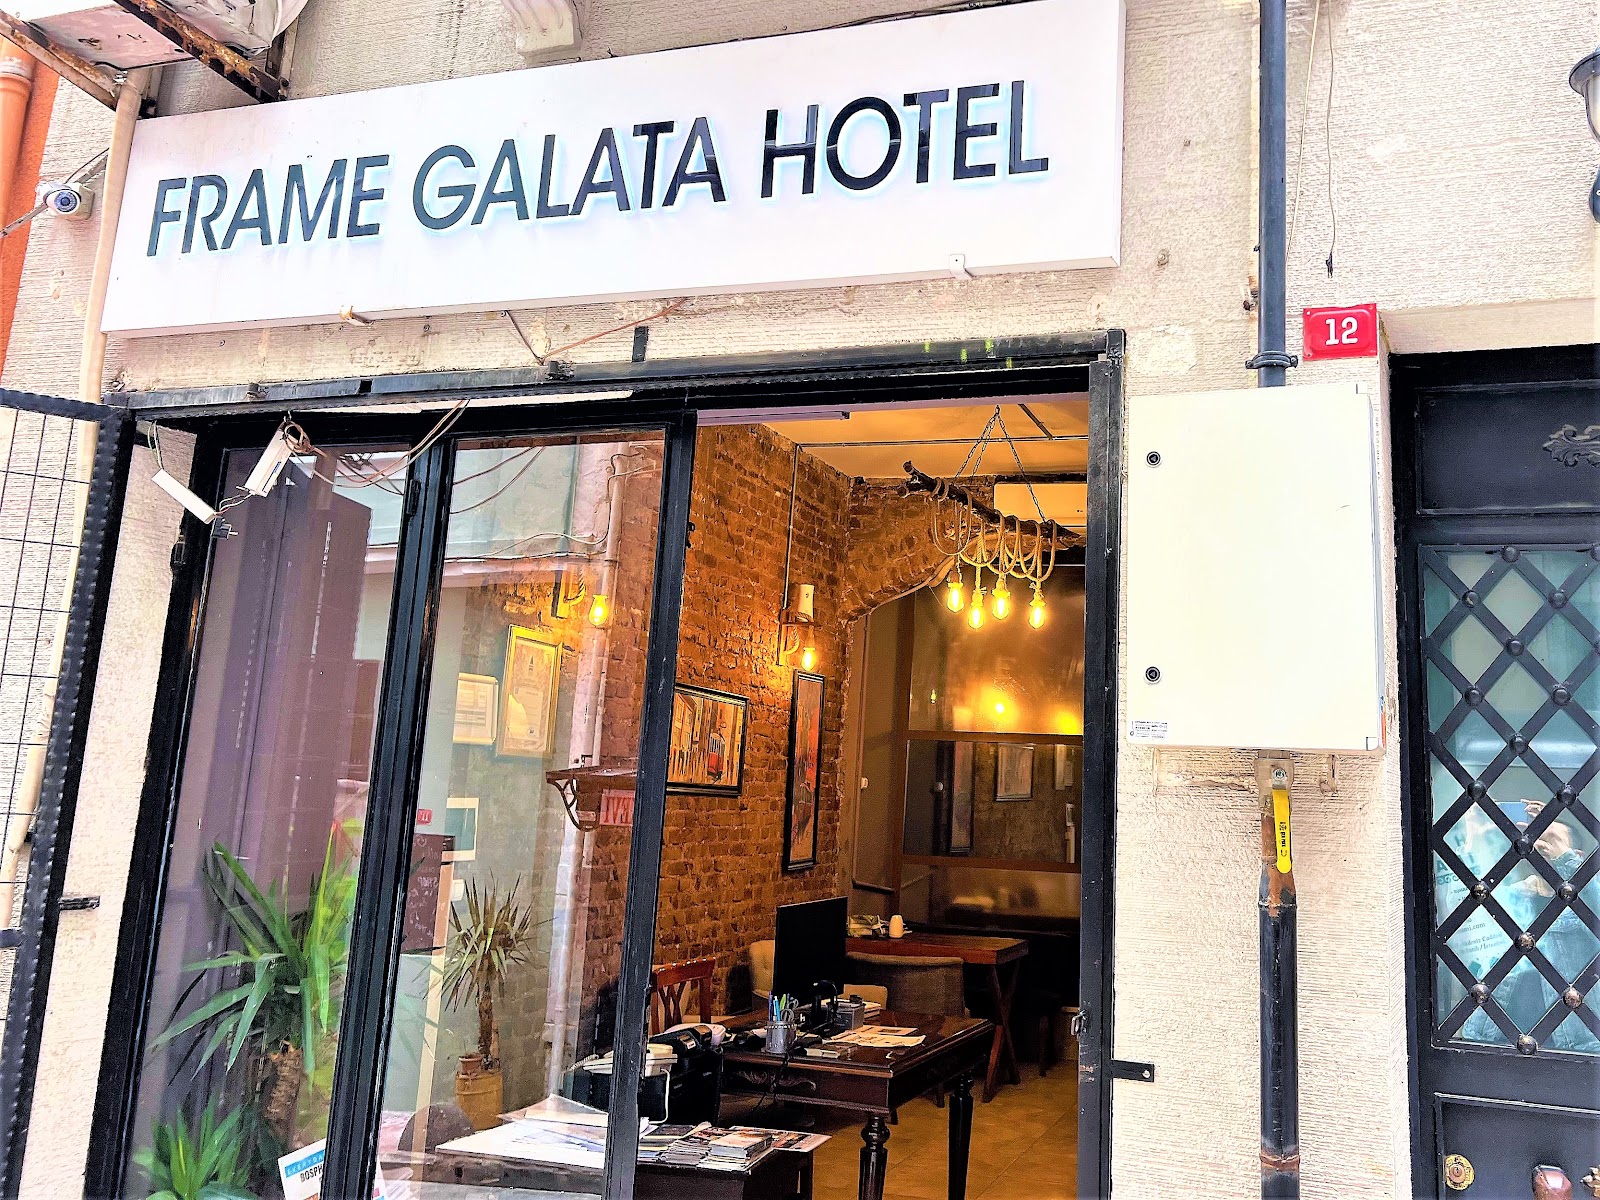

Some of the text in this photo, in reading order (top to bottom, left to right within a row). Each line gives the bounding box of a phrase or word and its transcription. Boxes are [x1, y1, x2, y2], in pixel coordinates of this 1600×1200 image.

[147, 79, 1049, 257] FRAME GALATA HOTEL
[1325, 316, 1358, 346] 12
